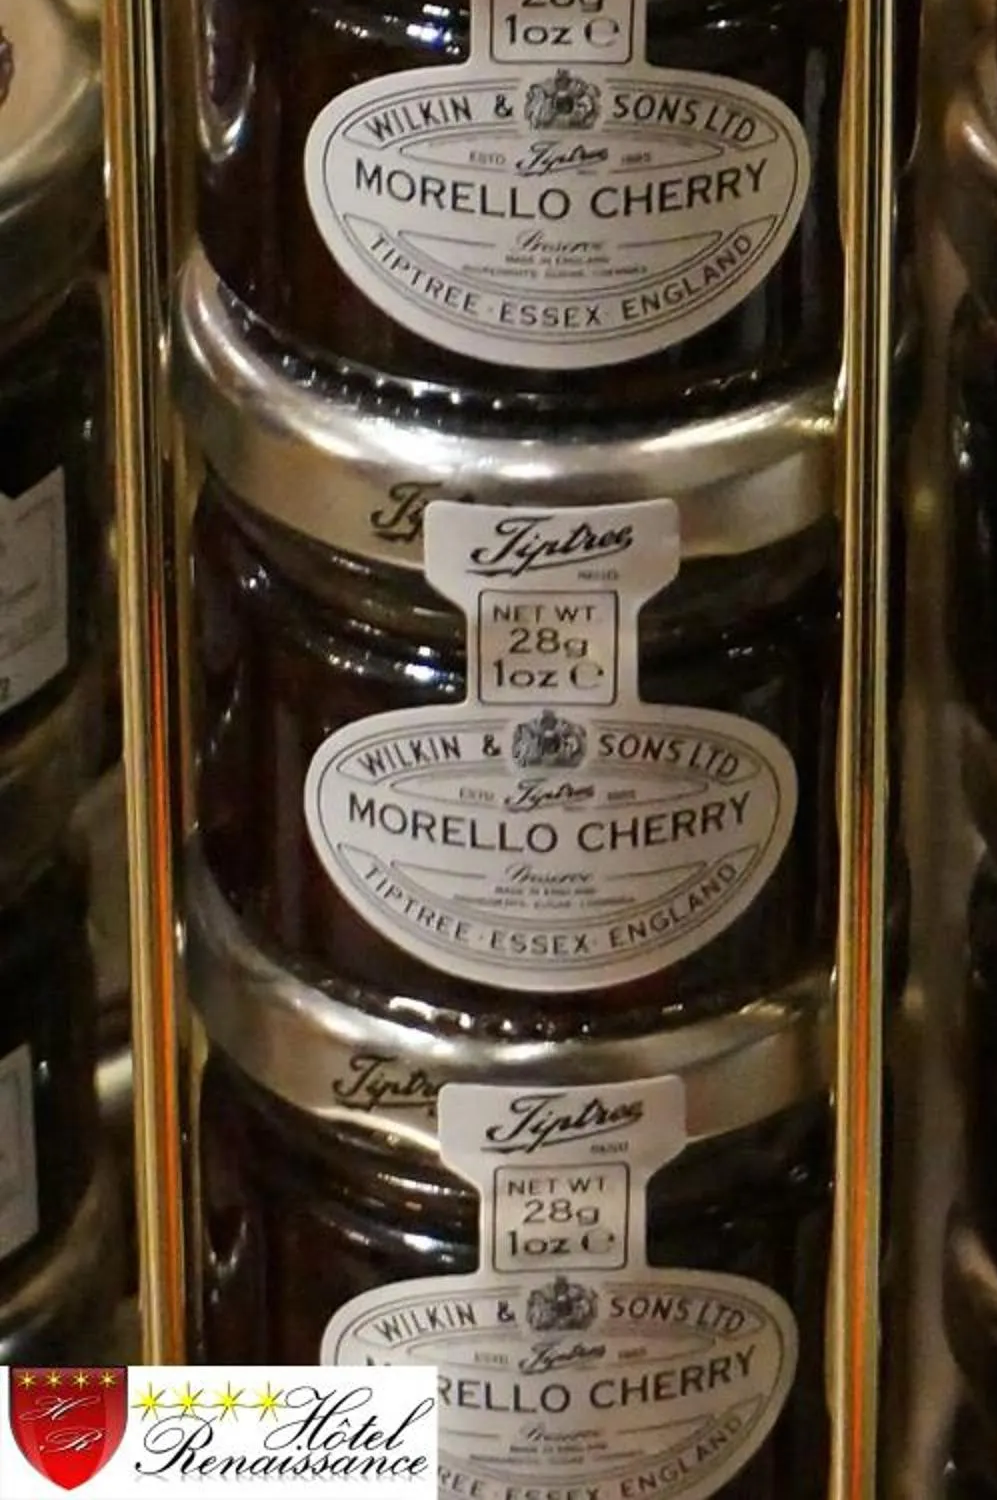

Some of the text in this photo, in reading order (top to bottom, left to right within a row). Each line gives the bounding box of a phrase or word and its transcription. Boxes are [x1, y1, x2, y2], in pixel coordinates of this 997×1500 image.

[505, 15, 573, 46] 1oz
[362, 93, 758, 144] WILKIN & SONS LTD
[355, 156, 769, 221] MORELLO CHERRY
[369, 230, 754, 329] TIPTREE ESSEX ENGLAND
[465, 515, 635, 577] Tiptree
[492, 604, 545, 625] NET
[508, 627, 589, 659] 28g
[492, 661, 560, 689] 1oz
[357, 733, 740, 778] WILKIN & SONS LTD
[348, 790, 751, 853] MORELLO CHERRY
[363, 861, 740, 955] TIPTREE ESSEX ENGLAND
[332, 1053, 439, 1111] Tiptr
[481, 1093, 644, 1153] Tiptree
[506, 1177, 559, 1197] NET
[523, 1199, 601, 1225] 28g
[506, 1229, 573, 1258] 1oz
[374, 1299, 746, 1343] WILKIN & SONS LTD
[589, 1345, 756, 1409] CHERRY
[620, 1414, 743, 1498] ENGLAND
